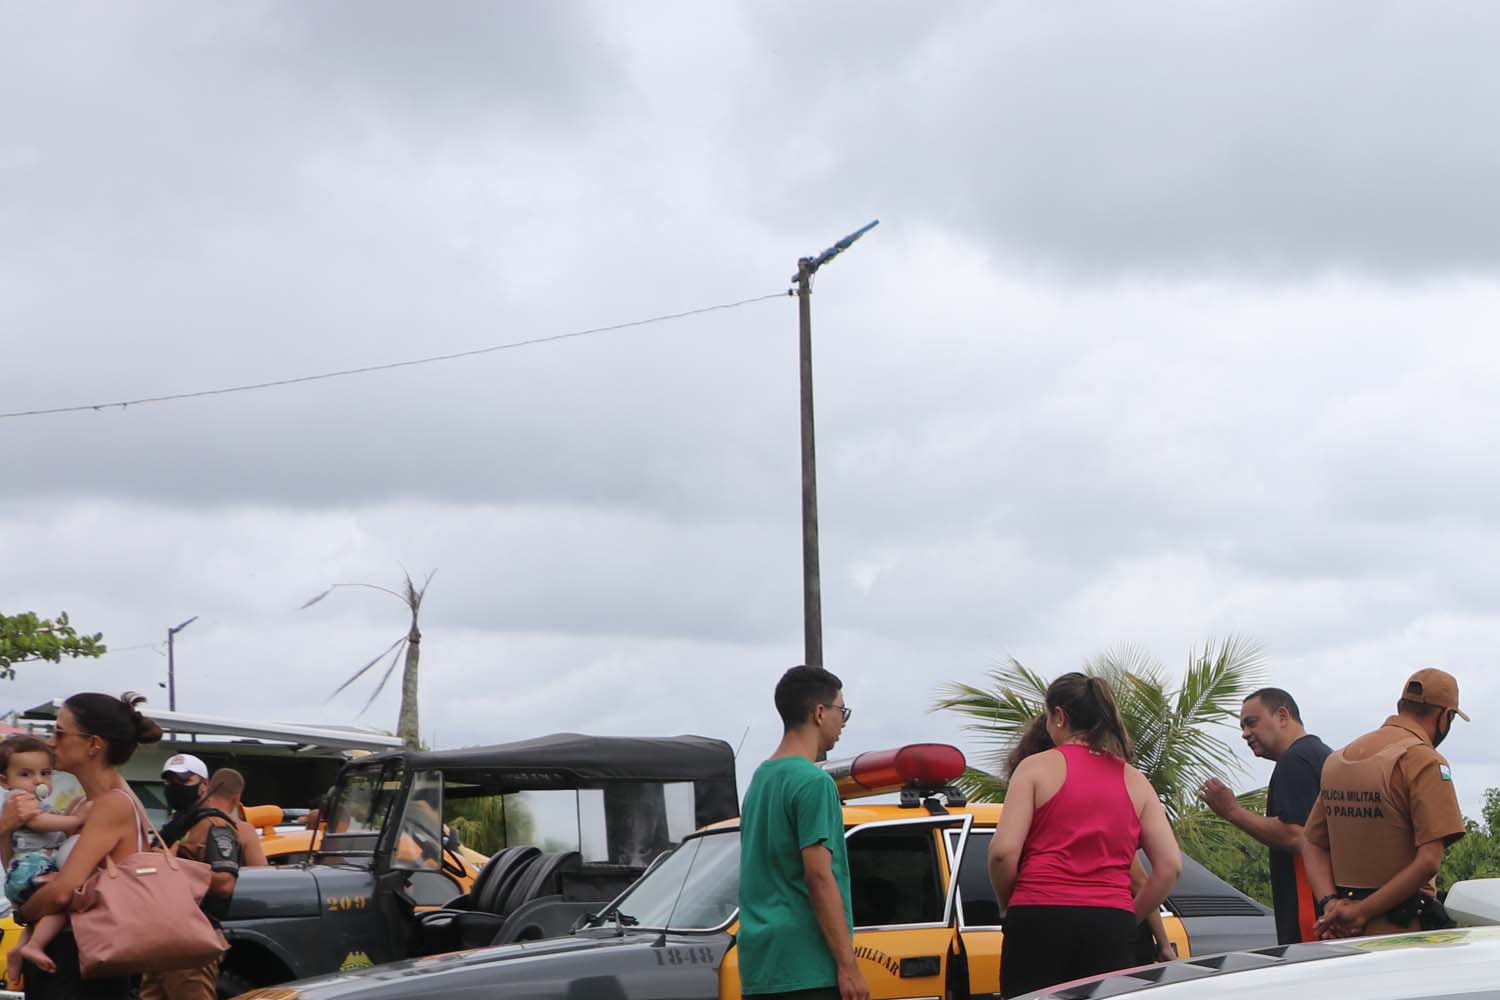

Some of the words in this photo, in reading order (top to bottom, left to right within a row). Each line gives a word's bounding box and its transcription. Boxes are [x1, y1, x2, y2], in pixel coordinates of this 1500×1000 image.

[1347, 791, 1381, 802] MILITAR
[326, 896, 366, 911] 209
[653, 947, 715, 967] 1848
